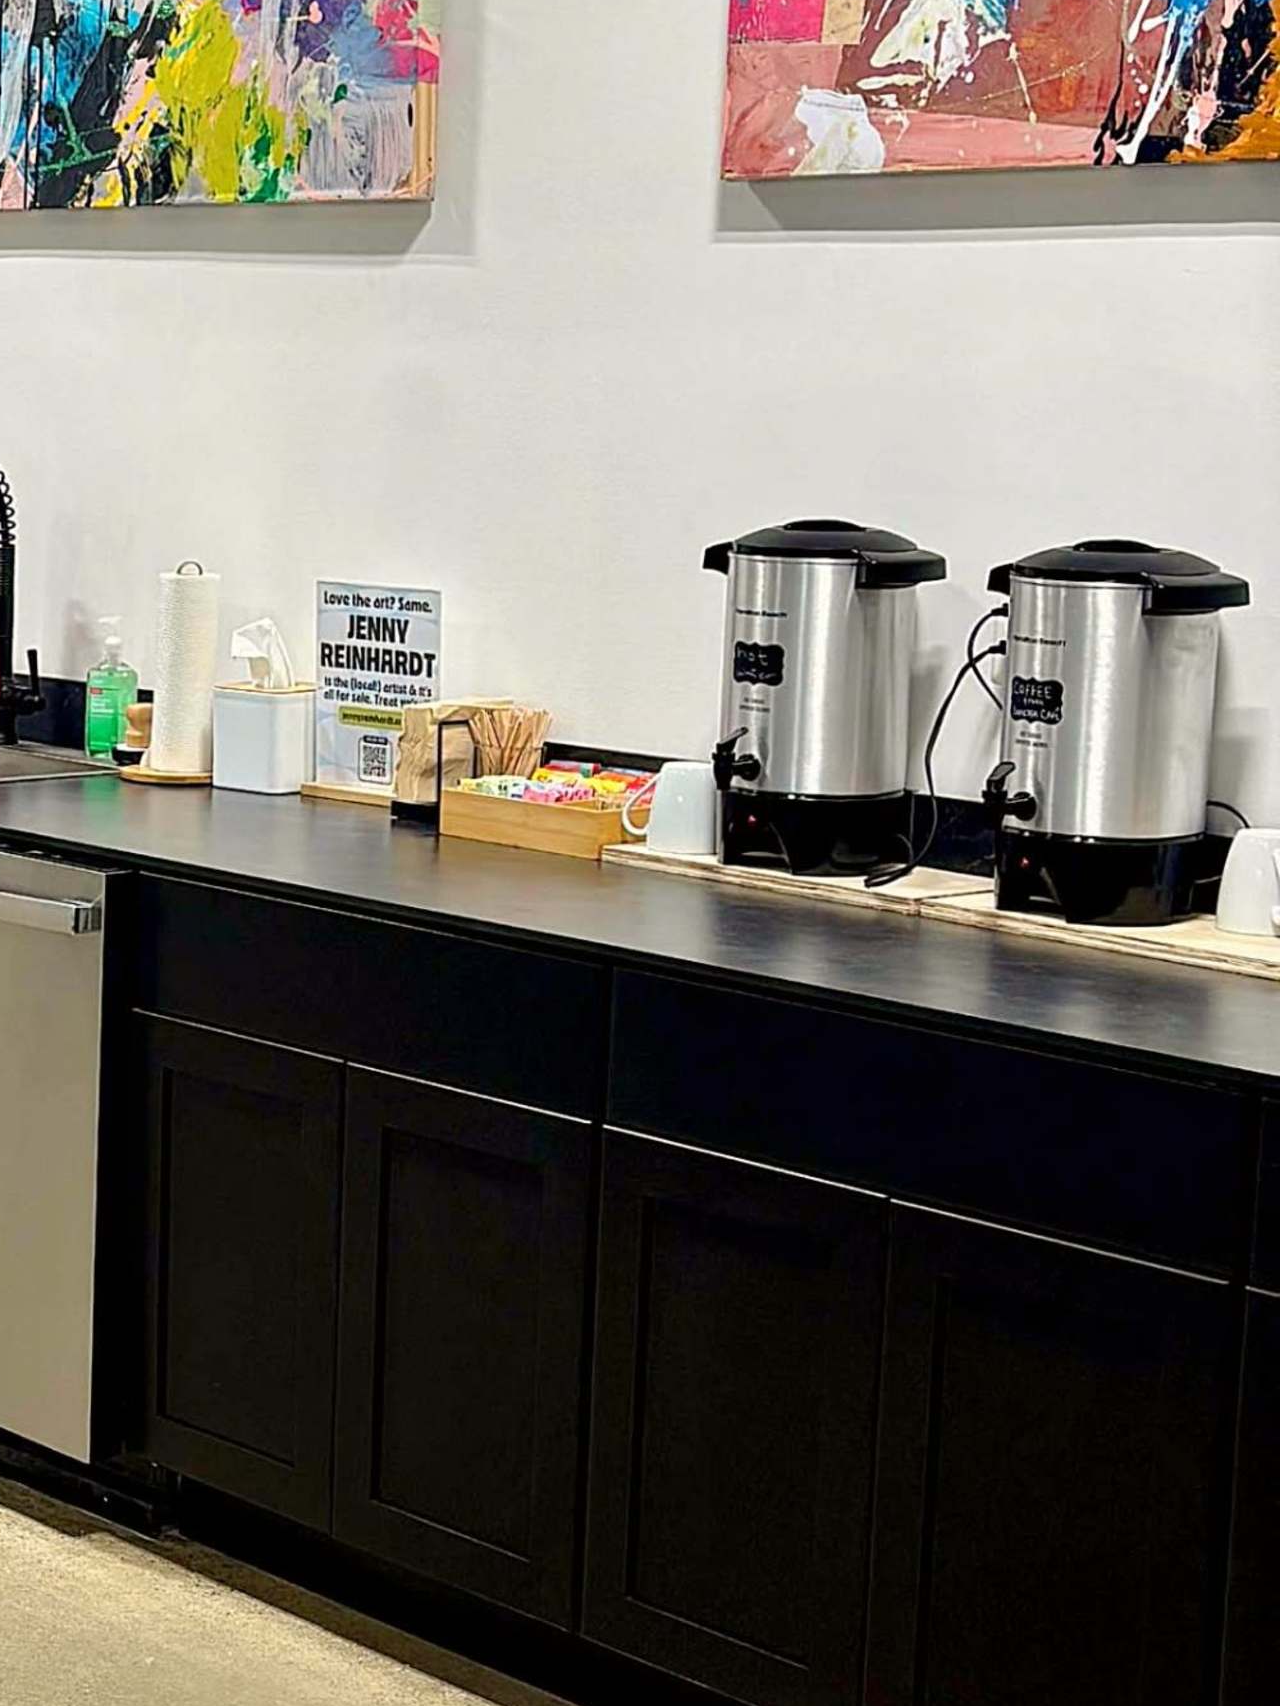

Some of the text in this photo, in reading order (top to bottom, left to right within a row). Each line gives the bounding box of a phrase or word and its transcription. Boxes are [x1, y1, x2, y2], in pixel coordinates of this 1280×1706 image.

[323, 590, 432, 613] Love the art? Same.
[347, 614, 409, 644] JENNY
[320, 642, 436, 678] REINHARDT
[333, 676, 349, 689] the
[383, 683, 407, 695] artist
[409, 684, 417, 696] &
[336, 689, 350, 702] for
[374, 694, 398, 708] Treat
